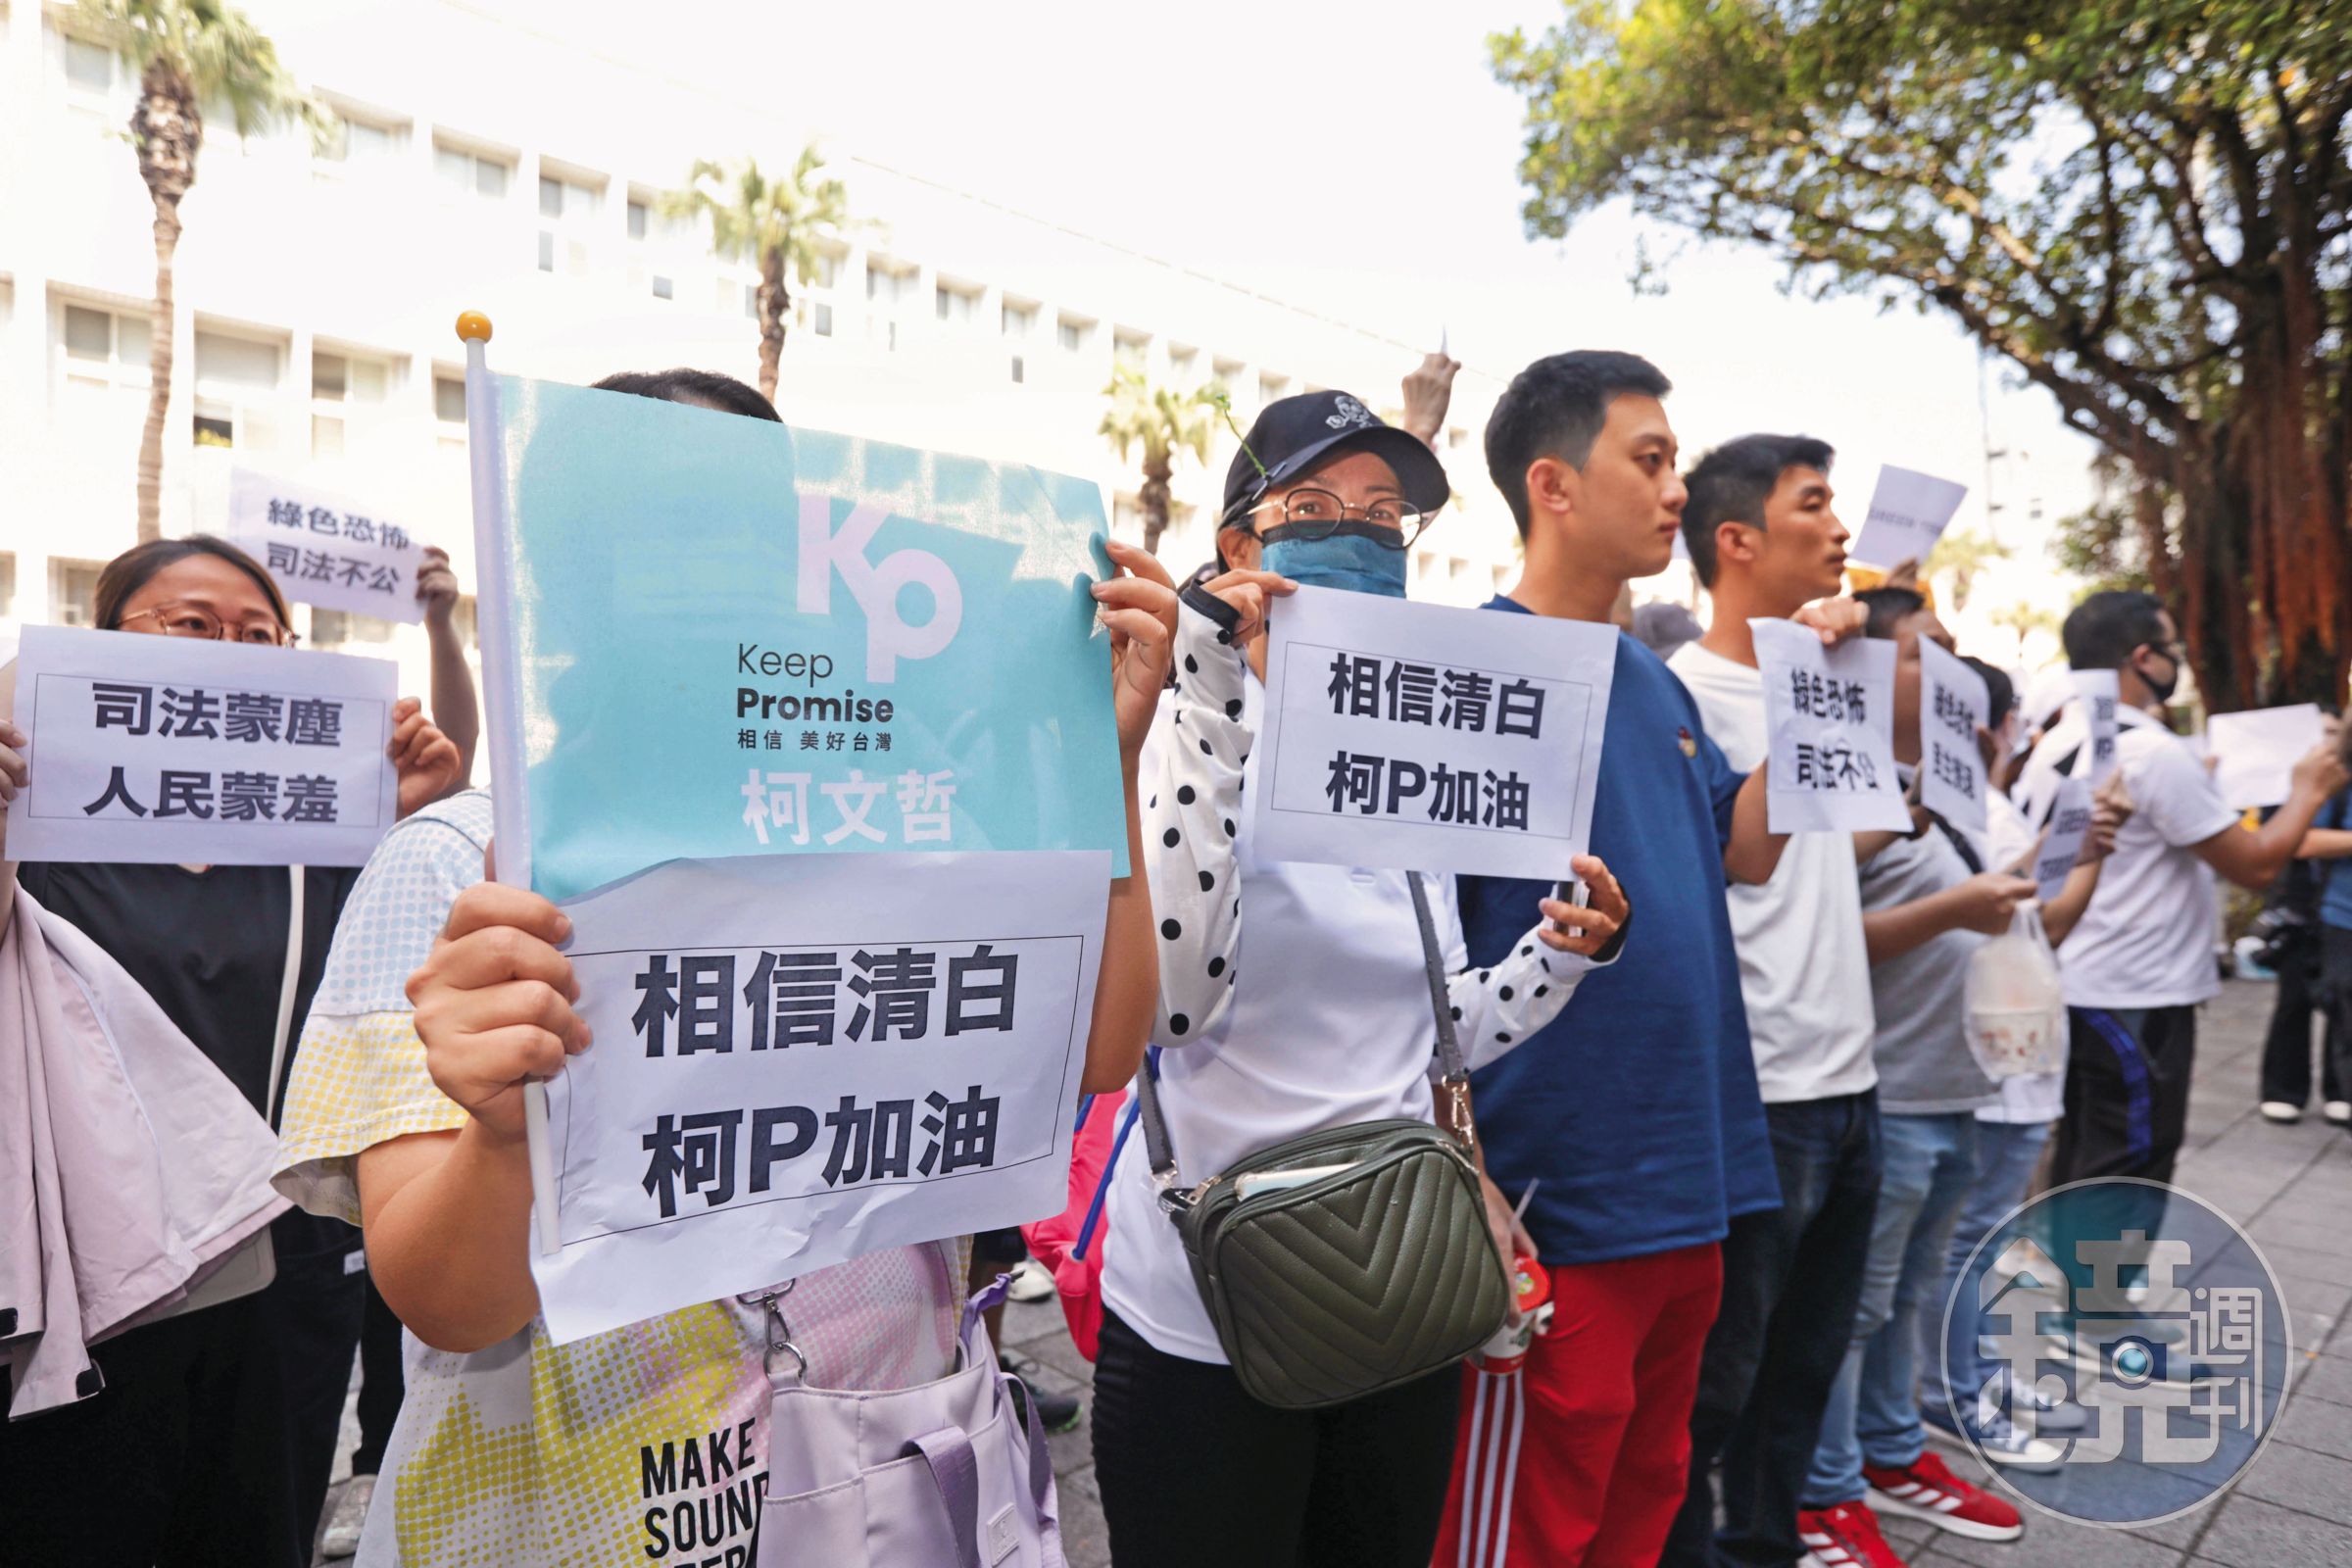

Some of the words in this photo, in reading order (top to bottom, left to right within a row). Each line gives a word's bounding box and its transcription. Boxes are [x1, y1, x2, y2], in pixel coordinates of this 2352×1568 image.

[268, 498, 409, 550] 綠色恐怖
[268, 541, 400, 595] 司法不公
[738, 643, 833, 688] Keep
[1328, 652, 1545, 740] 相信清白
[92, 682, 343, 748] 司法蒙塵
[737, 688, 894, 723] Promise
[737, 728, 783, 751] 相信
[800, 729, 892, 752] 美好台灣
[83, 766, 338, 823] 人民蒙羞
[740, 768, 956, 846] 柯文哲
[1326, 751, 1530, 831] 柯P加油
[632, 944, 1019, 1058] 相信清白
[642, 1085, 1001, 1219] 柯P加油
[641, 1417, 756, 1498] MAKE
